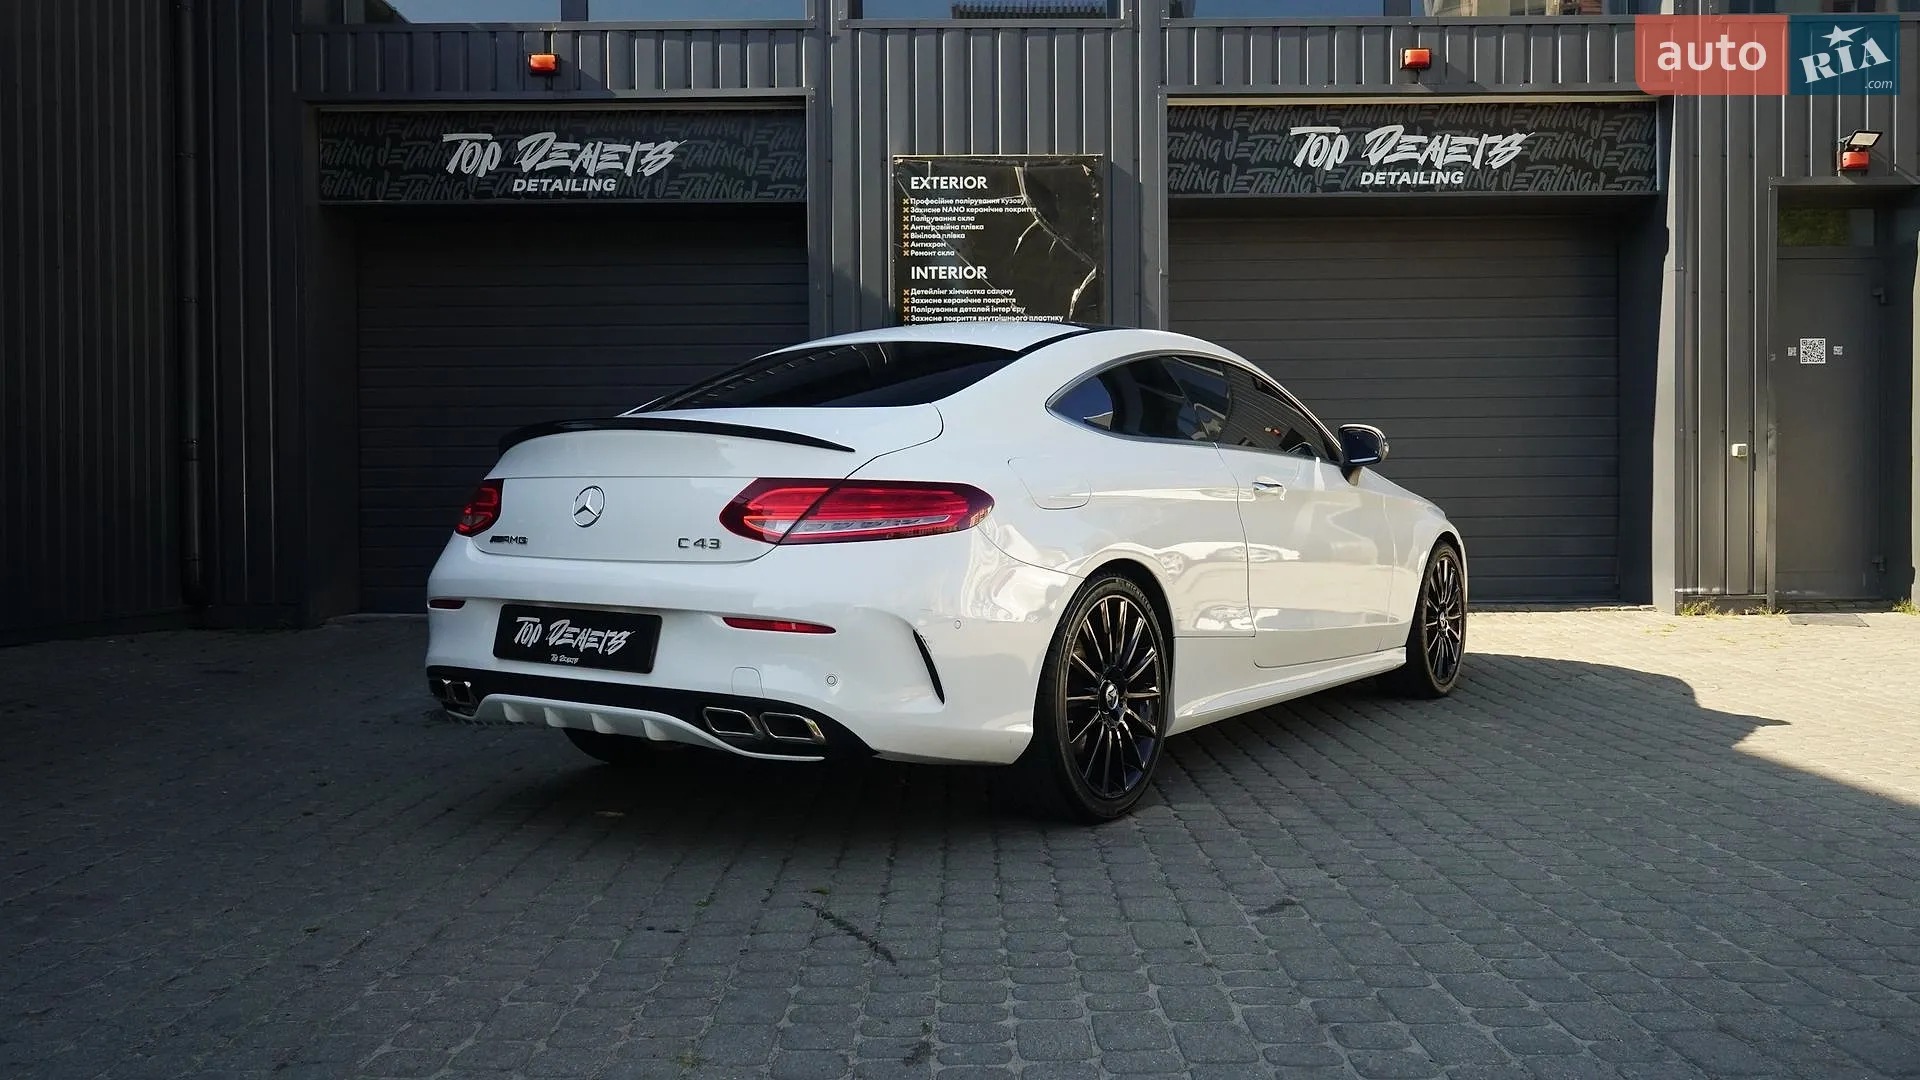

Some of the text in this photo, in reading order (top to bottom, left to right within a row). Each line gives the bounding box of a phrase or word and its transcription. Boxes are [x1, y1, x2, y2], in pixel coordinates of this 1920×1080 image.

[1361, 171, 1464, 185] DETAILING
[513, 178, 617, 192] DETAILING
[910, 176, 988, 189] EXTERIOR
[910, 198, 1025, 206] Професійне полірування кузову
[966, 206, 1003, 214] керамічне
[910, 223, 960, 231] Антигравійна
[910, 241, 946, 249] Антихром
[910, 266, 988, 280] INTERIOR
[910, 288, 947, 296] Детейлінг
[943, 297, 981, 305] керамічне
[910, 306, 958, 314] Полірування
[959, 306, 990, 314] деталей
[978, 314, 1028, 323] внутрішнього
[1028, 315, 1064, 323] пластику
[500, 535, 529, 545] AMG
[677, 537, 721, 549] C 43
